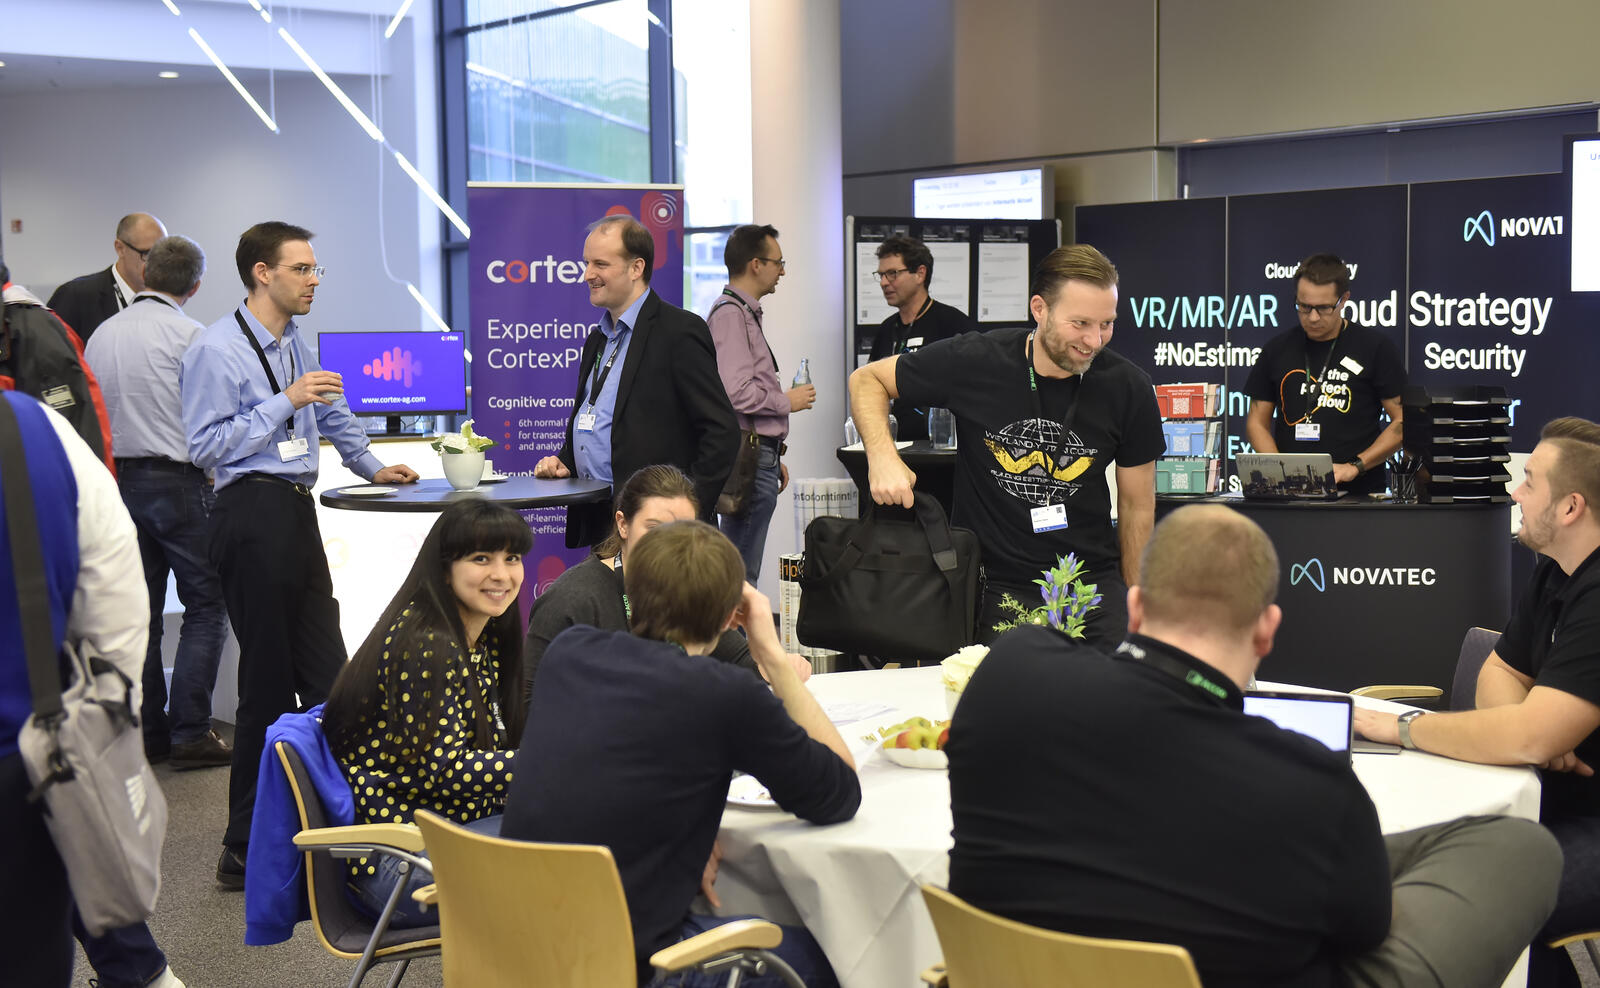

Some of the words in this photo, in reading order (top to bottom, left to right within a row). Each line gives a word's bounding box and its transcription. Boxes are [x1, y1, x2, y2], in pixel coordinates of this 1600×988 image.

[1501, 215, 1564, 237] NOVAT
[1130, 294, 1279, 330] VR/MR/AR
[1409, 290, 1553, 335] Strategy
[1154, 342, 1263, 367] #NoEstima
[1423, 342, 1526, 377] Security
[1327, 368, 1350, 382] the
[361, 396, 426, 405] www.cortex-ag.com
[488, 396, 547, 411] Cognitive
[549, 399, 575, 408] com
[1317, 395, 1346, 409] flow
[518, 418, 533, 427] 6th
[537, 418, 563, 427] normal
[518, 430, 531, 440] for
[532, 430, 566, 440] transact
[518, 442, 534, 451] and
[1333, 567, 1437, 586] NOVATEC
